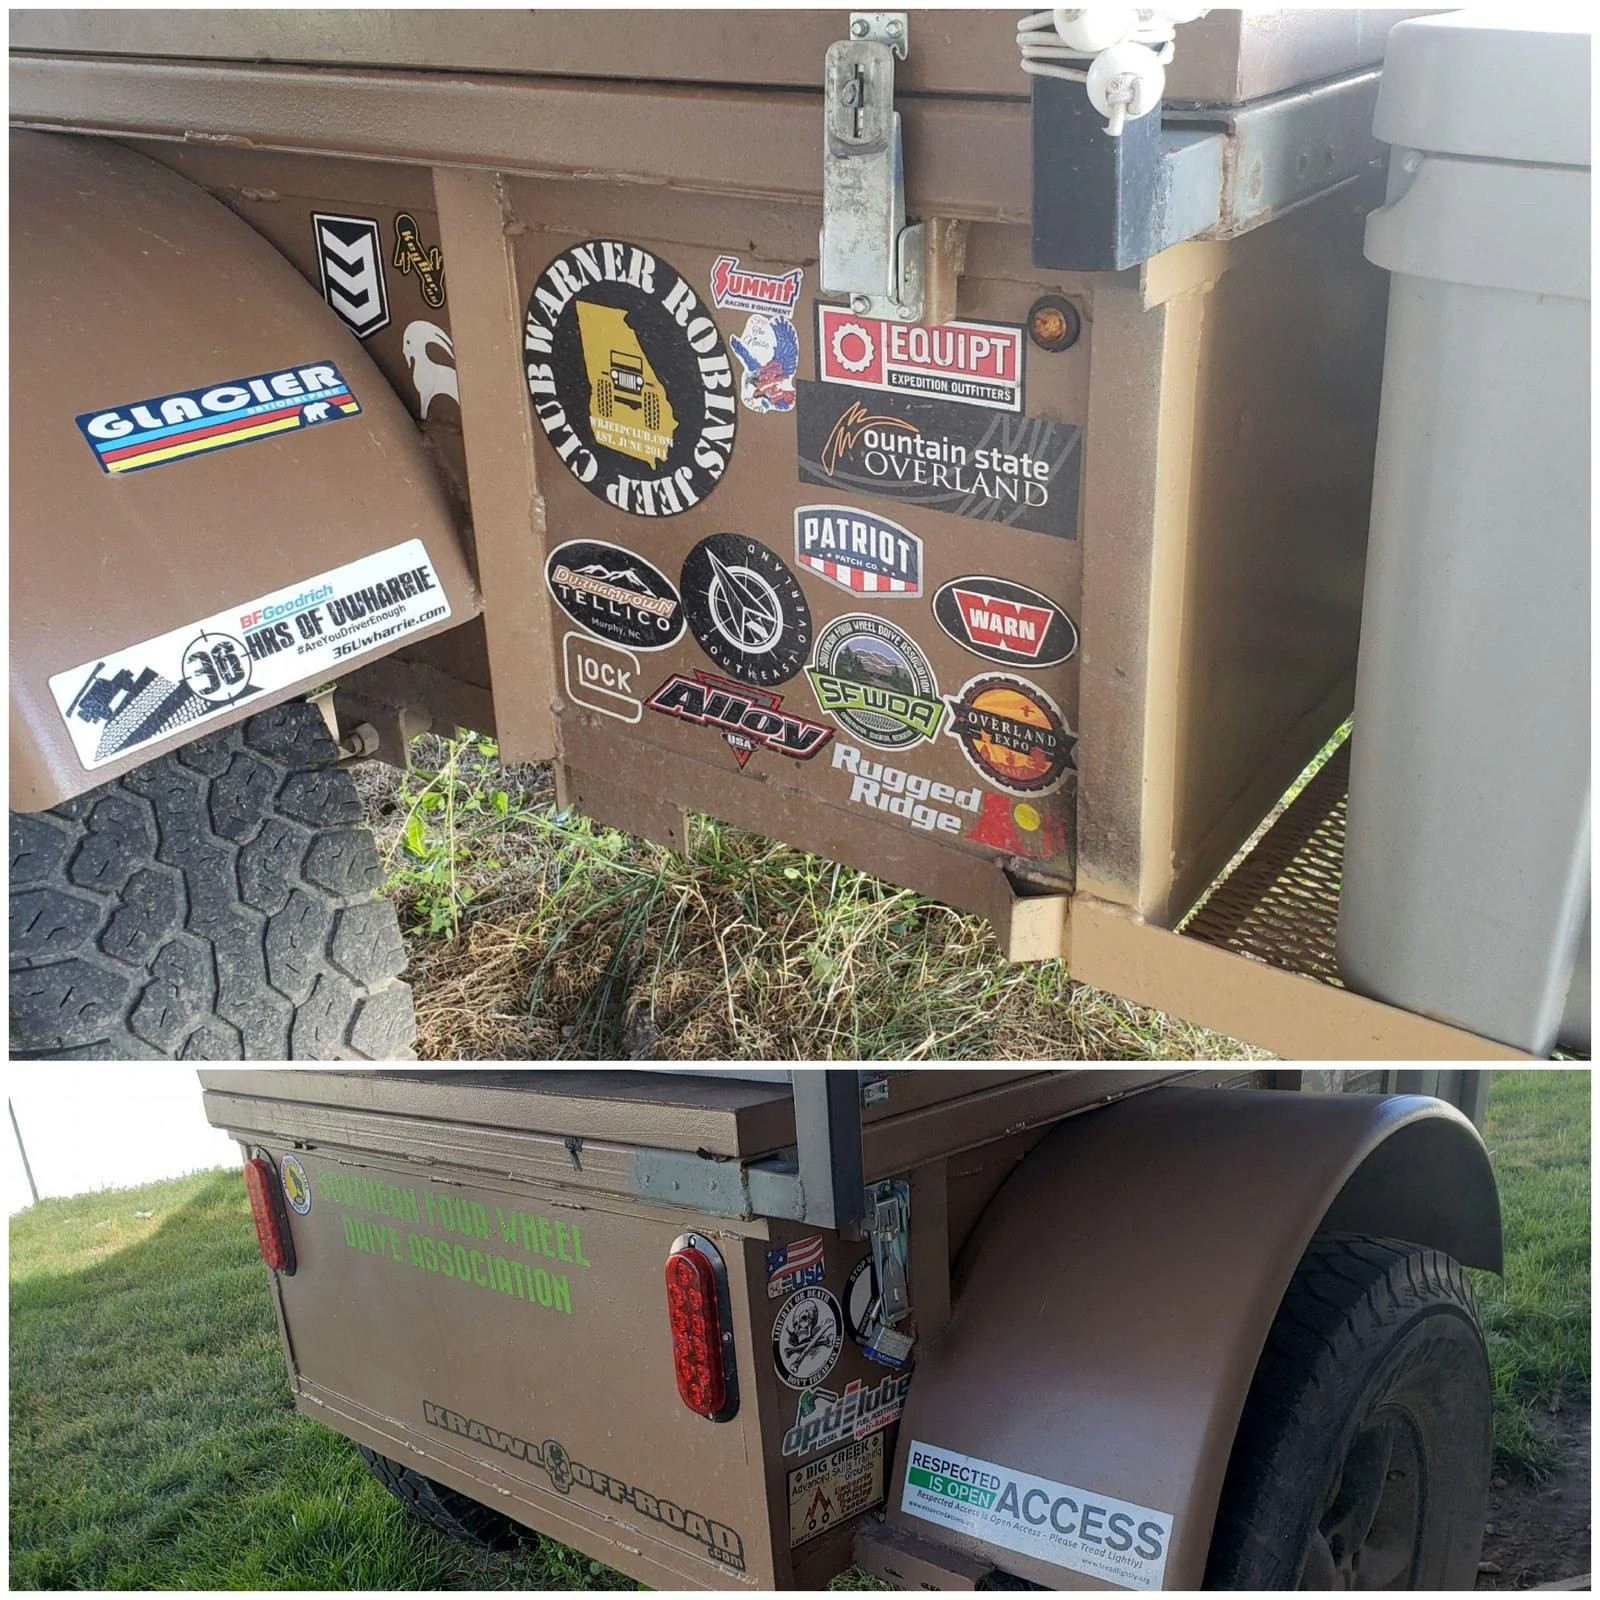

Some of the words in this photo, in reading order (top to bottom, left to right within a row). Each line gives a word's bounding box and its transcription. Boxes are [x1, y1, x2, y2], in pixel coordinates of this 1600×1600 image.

[525, 242, 657, 354] WARNER
[662, 276, 735, 479] ROBINS
[890, 325, 1012, 375] EQUIPT
[87, 366, 343, 439] GLACIER
[891, 373, 948, 393] EXPEDITION
[951, 380, 1012, 402] OUTFITTERS
[527, 363, 599, 483] CLUB
[618, 438, 643, 453] JUNE
[864, 451, 1049, 507] OVERLAND
[974, 447, 1049, 481] state
[606, 466, 700, 516] JEEP
[804, 517, 911, 574] PATRIOT
[835, 553, 863, 567] PATCH
[865, 561, 880, 571] CO.
[240, 583, 334, 629] BFGoodrich
[559, 585, 671, 632] TELLICO
[591, 616, 625, 637] Murphy,
[627, 628, 641, 640] NC
[968, 606, 1036, 642] WARN
[187, 640, 245, 695] 36
[245, 620, 296, 662] HRS
[295, 607, 324, 640] OF
[326, 565, 436, 627] UWHARRIE
[297, 604, 406, 656] #AreYouDriverEnough
[332, 603, 447, 660] 36Uwharrie.com
[700, 634, 799, 681] SOUTHEAST
[818, 677, 935, 730] SFWDA
[726, 734, 752, 750] USA
[967, 711, 1058, 748] OVERLAND
[995, 733, 1031, 752] EXPO
[831, 742, 983, 814] Rugged
[849, 775, 963, 834] Ridge
[791, 1263, 826, 1288] USA
[850, 1258, 865, 1282] STOP
[773, 1297, 797, 1342] LIBERTY
[794, 1291, 806, 1305] OR
[806, 1289, 830, 1302] DEATH
[817, 1433, 839, 1448] DIESEL
[856, 1415, 871, 1427] FUEL
[423, 1400, 548, 1469] KRAWL
[568, 1461, 744, 1558] OFF-ROAD
[791, 1471, 831, 1497] Advanced
[832, 1461, 852, 1477] Skills
[854, 1446, 882, 1466] Training
[806, 1463, 828, 1480] BIG
[831, 1440, 869, 1466] CREEK
[845, 1461, 874, 1480] Grounds
[912, 1451, 1001, 1491] RESPECTED
[928, 1475, 943, 1491] IS
[947, 1482, 991, 1509] OPEN
[917, 1489, 954, 1509] Respected
[954, 1502, 980, 1518] Access
[990, 1514, 1012, 1529] Open
[1013, 1521, 1042, 1538] Access
[1050, 1533, 1078, 1549] Please
[1081, 1543, 1106, 1557] Tread
[1108, 1550, 1144, 1570] Lightly!
[995, 1481, 1165, 1561] ACCESS
[1081, 1557, 1151, 1586] www.treadlightly.org
